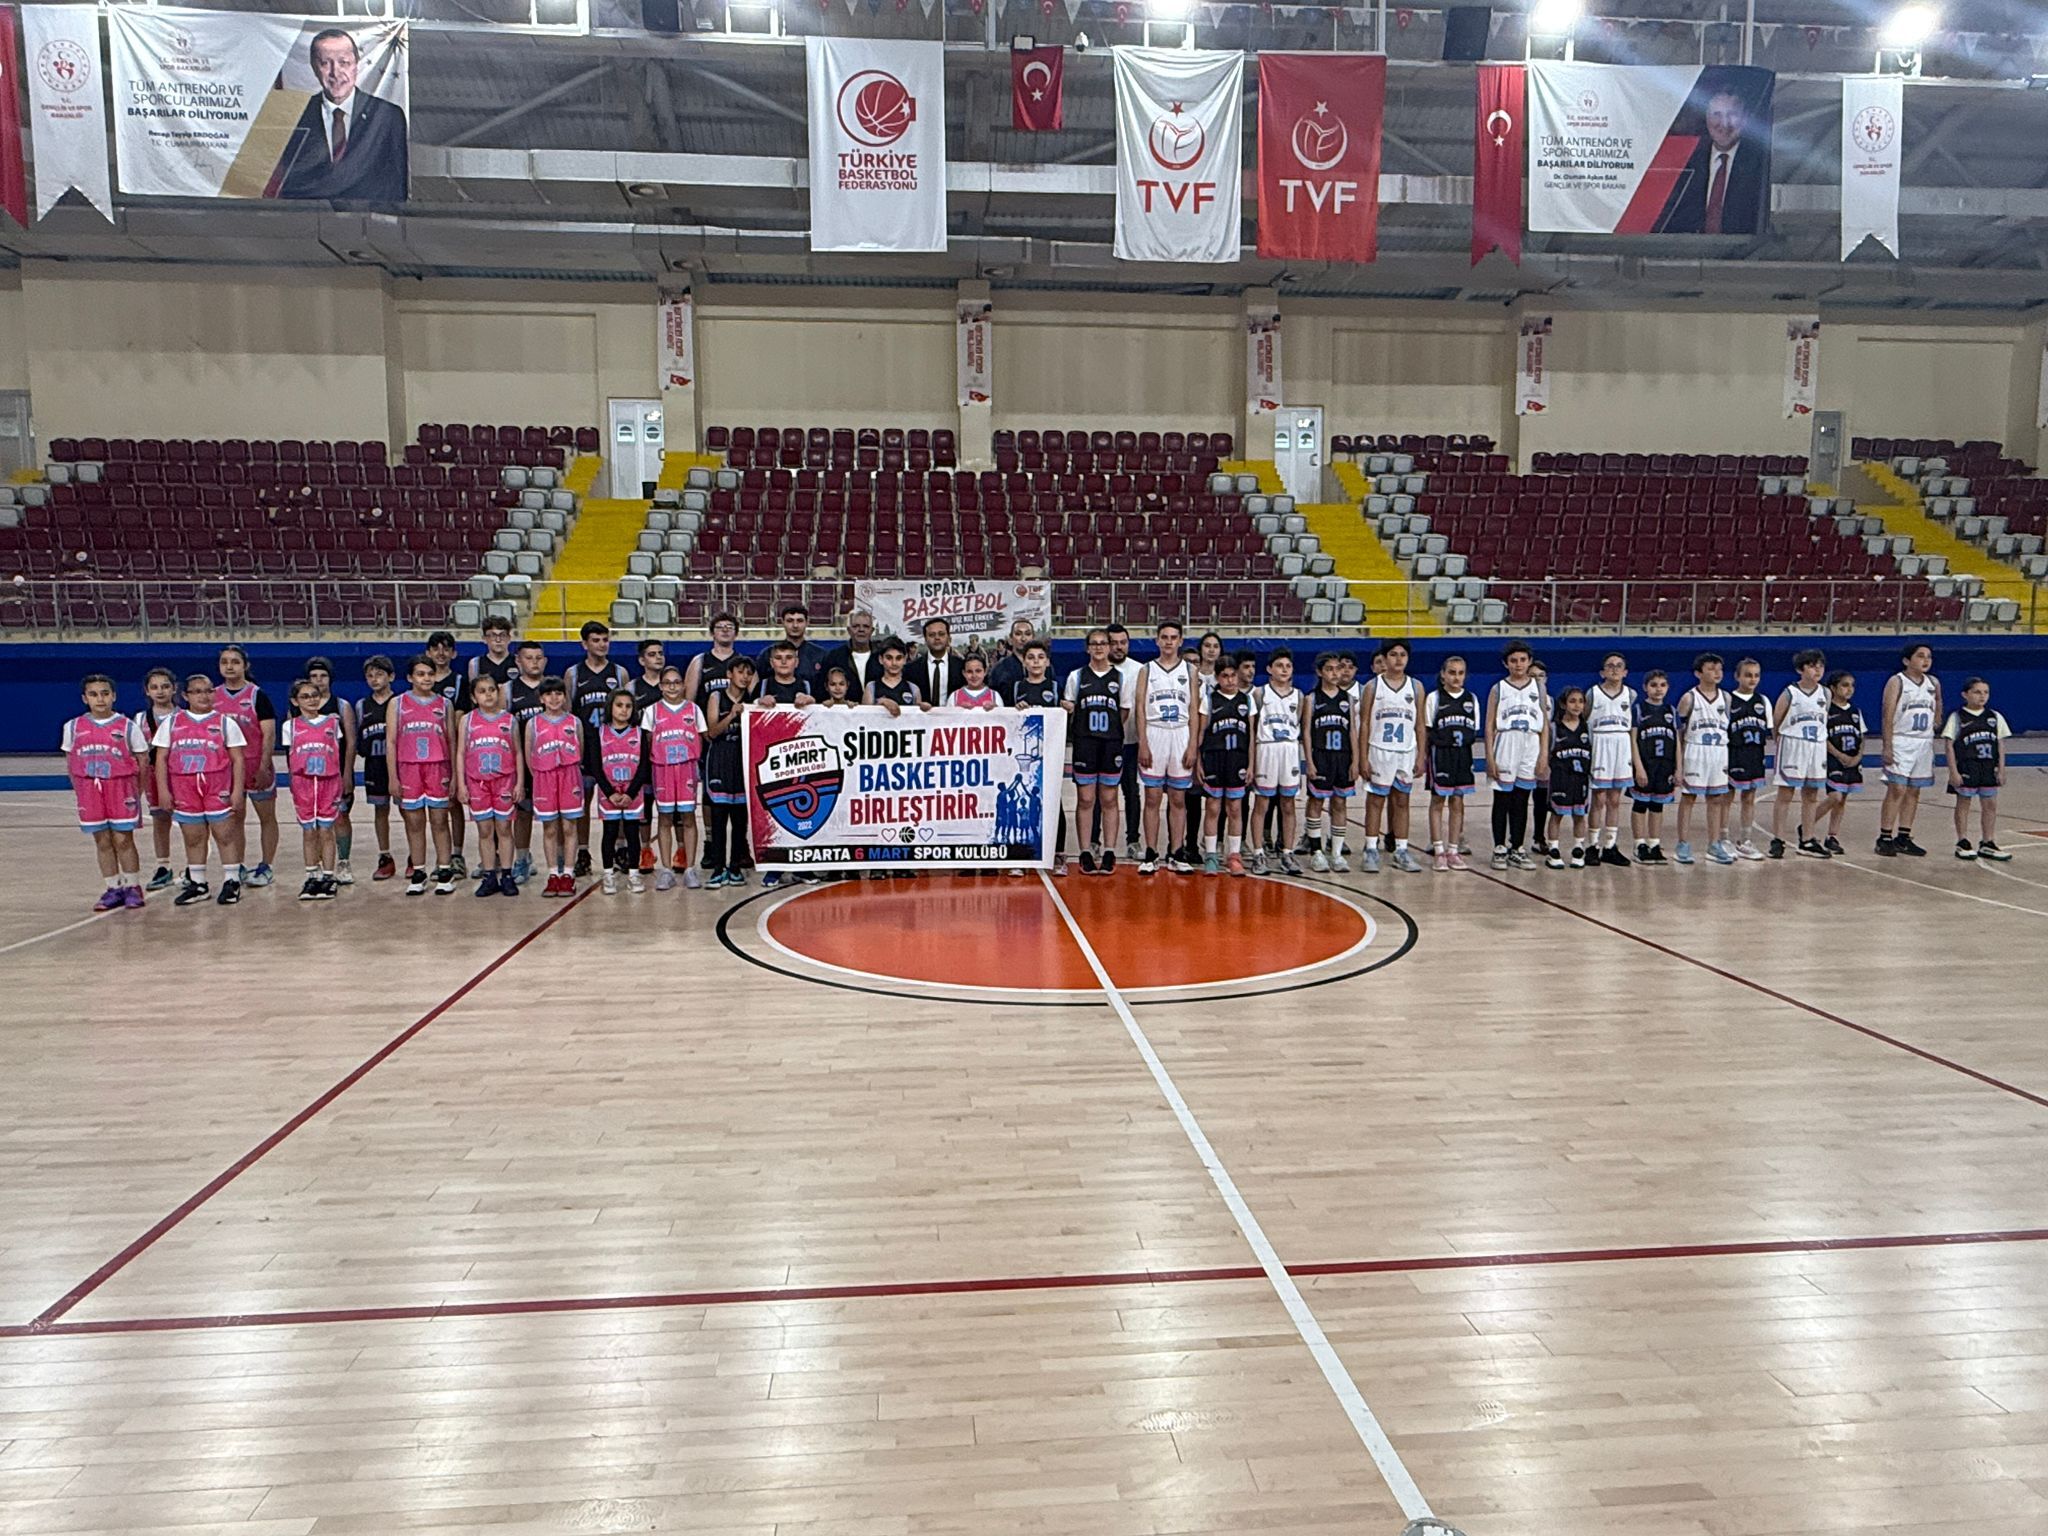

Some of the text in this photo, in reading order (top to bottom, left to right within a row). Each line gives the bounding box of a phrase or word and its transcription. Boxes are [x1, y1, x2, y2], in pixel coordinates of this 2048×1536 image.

[128, 80, 244, 96] TÜM ANTRENÖR VE
[133, 93, 242, 108] SPORCULARIMIZA
[127, 107, 249, 121] BAŞARILAR DİLİYORUM
[193, 131, 230, 139] ERDOĞAN
[1540, 135, 1633, 149] TÜM ANTRENÖR VE
[838, 148, 917, 169] TÜRKİYE
[1543, 147, 1630, 159] SPORCULARIMIZA
[1537, 159, 1634, 170] BAŞARILAR DİLİYORUM
[838, 169, 918, 180] BASKETBOL
[838, 181, 918, 190] FEDERASYONU
[1137, 180, 1216, 214] TVF
[1279, 179, 1358, 214] TVF
[920, 581, 976, 598] ISPARTA
[903, 591, 1008, 622] BASKETBOL
[1089, 711, 1110, 733] 00
[1912, 713, 1929, 732] 10
[1325, 731, 1342, 751] 18
[1382, 723, 1405, 743] 24
[1453, 731, 1463, 747] 3
[779, 741, 816, 753] ISPARTA
[843, 725, 1013, 766] ŞİDDET AYIRIR,
[1225, 734, 1238, 751] 11
[1655, 740, 1664, 757] 2
[181, 754, 207, 775] 77
[770, 748, 828, 771] 6 MART
[775, 763, 826, 779] SPOR KULÜBÜ
[859, 759, 994, 792] BASKETBOL
[850, 789, 995, 827] BİRLEŞTİRİR...
[788, 844, 1008, 862] ISPARTA 6 MART SPOR KULÜBÜ
